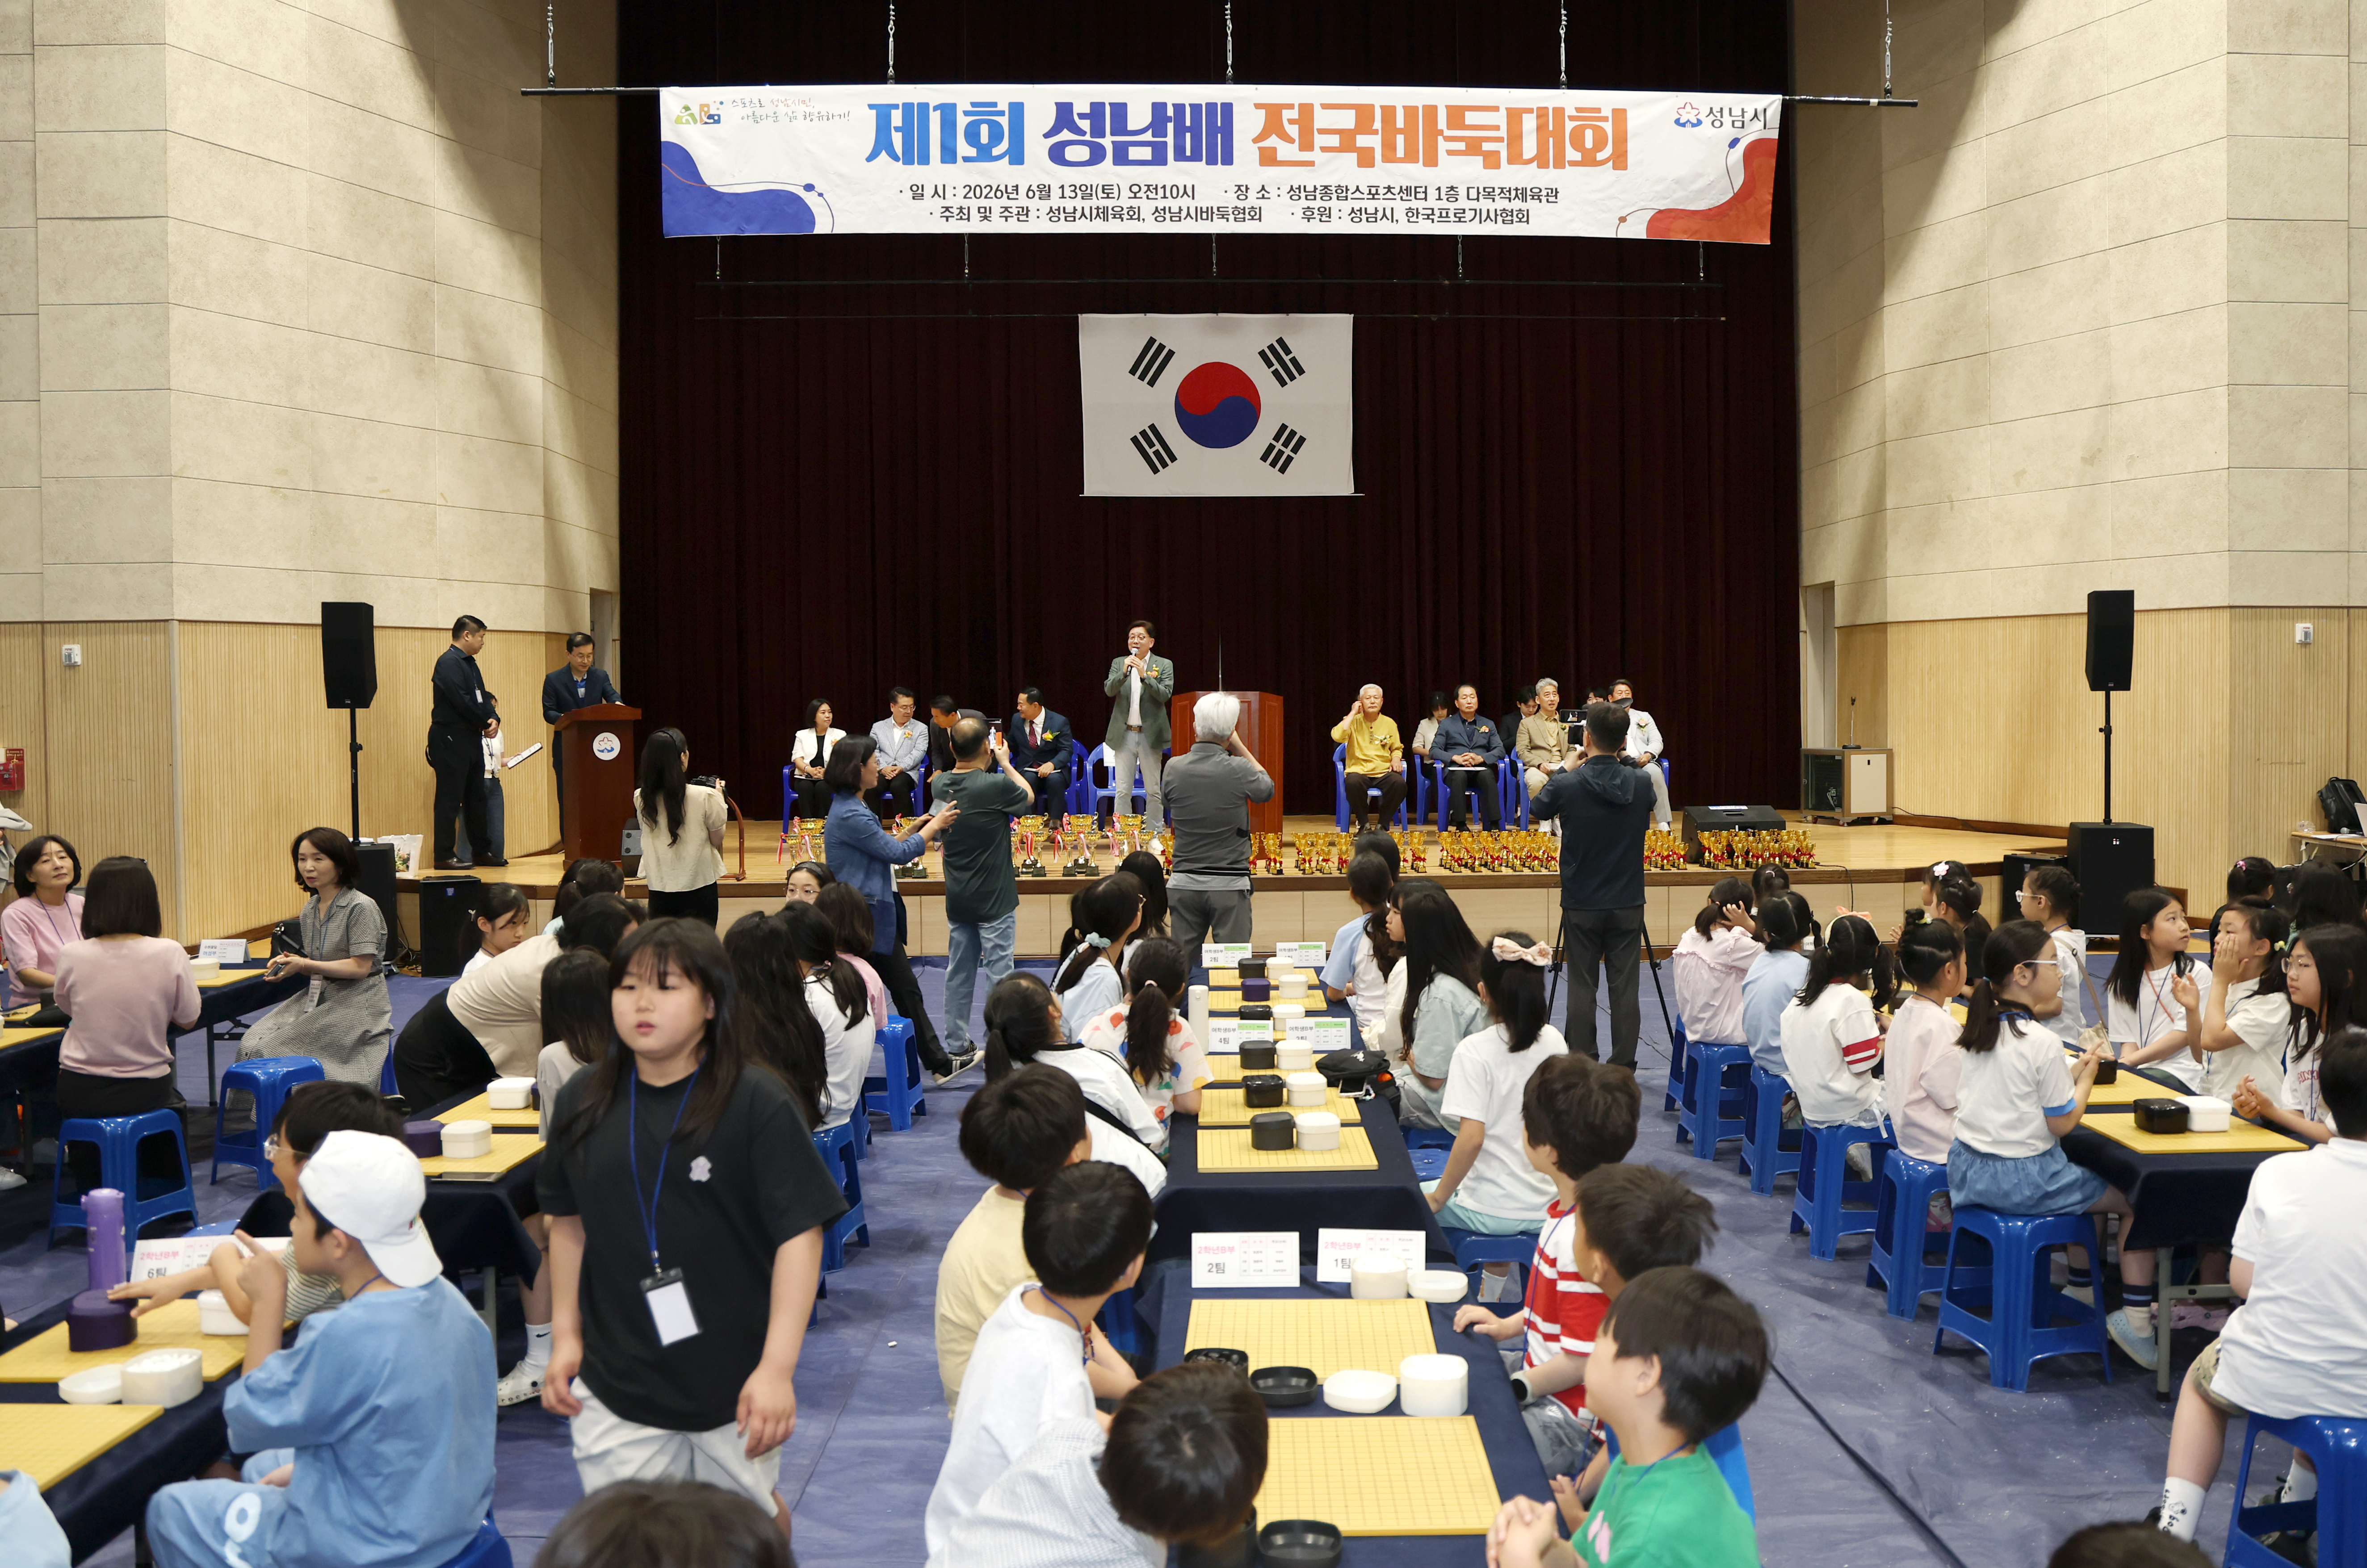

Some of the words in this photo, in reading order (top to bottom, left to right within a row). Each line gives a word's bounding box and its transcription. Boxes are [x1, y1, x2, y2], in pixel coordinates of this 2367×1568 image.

[731, 98, 765, 108] 스포츠로
[770, 97, 815, 108] 성남시민,
[741, 110, 780, 124] 아름다운
[784, 110, 798, 122] 삶
[802, 110, 850, 122] 향유하기!
[1705, 107, 1767, 130] 성남시
[865, 101, 1025, 166] 제1회
[1042, 101, 1234, 167] 성남배
[1251, 102, 1628, 171] 전국바둑대회
[910, 184, 924, 200] 일
[931, 184, 946, 200] 시
[963, 184, 1019, 200] 2026년
[1026, 184, 1051, 200] 6월
[1058, 183, 1121, 201] 13일(토)
[1128, 184, 1195, 200] 오전10시
[1234, 184, 1250, 201] 장
[1256, 184, 1271, 200] 소
[1287, 184, 1427, 202] 성남종합스포츠센터
[1435, 185, 1460, 203] 1층
[1466, 186, 1560, 204] 다목적체육관
[940, 205, 970, 222] 주최
[978, 206, 992, 222] 및
[999, 206, 1031, 222] 주관
[1046, 205, 1145, 223] 성남시체육회,
[1151, 205, 1262, 222] 성남시바둑협회
[1301, 206, 1332, 222] 후원
[1347, 207, 1399, 224] 성남시,
[1405, 206, 1530, 225] 한국프로기사협회
[1197, 1246, 1235, 1255] 2학년B부
[1324, 1241, 1362, 1250] 2학년B부
[139, 1251, 180, 1260] 2학년B부
[1207, 1262, 1225, 1274] 2팀
[1334, 1258, 1351, 1269] 1팀
